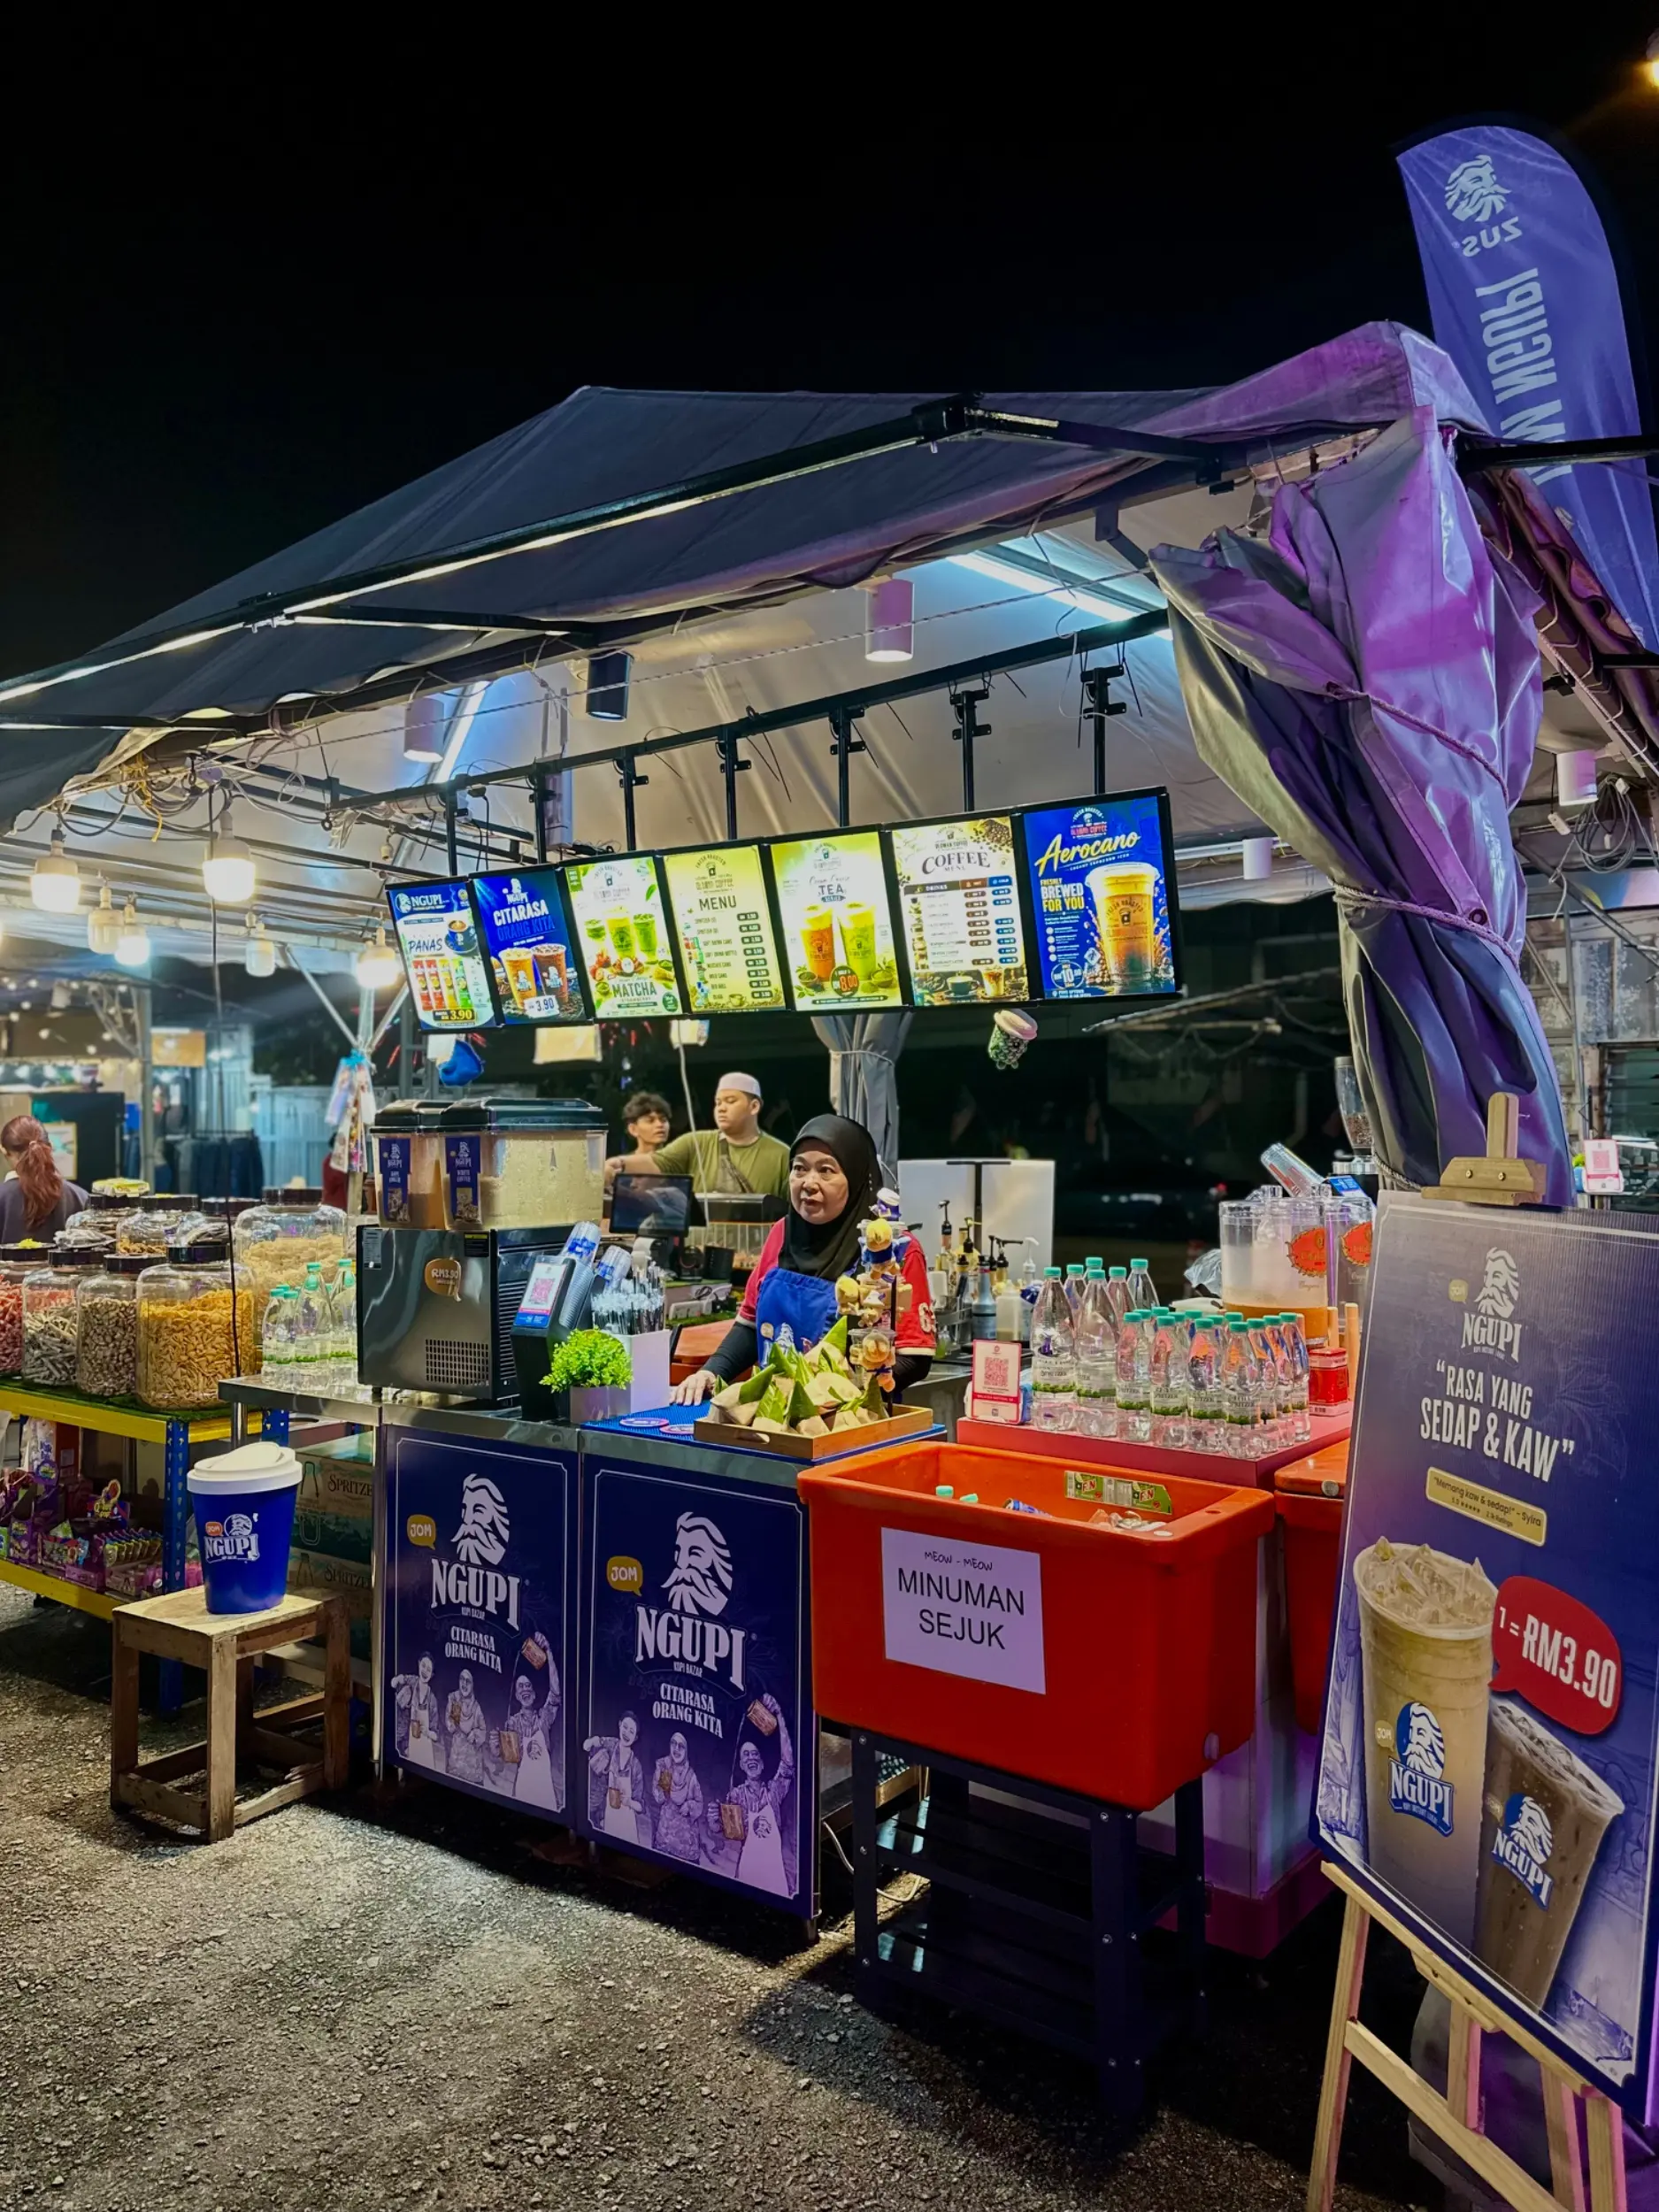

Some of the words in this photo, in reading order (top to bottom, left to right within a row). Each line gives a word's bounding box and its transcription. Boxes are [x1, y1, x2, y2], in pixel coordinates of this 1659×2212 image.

[922, 852, 991, 875] COFFEE
[1034, 831, 1141, 878] Aerocano
[411, 894, 442, 907] NGUPI
[818, 884, 844, 895] TEA
[1041, 882, 1084, 900] BREWED
[493, 899, 549, 926] CITARASA
[699, 895, 737, 911] MENU
[1042, 899, 1062, 912] FOR
[1064, 895, 1085, 910] YOU
[497, 920, 531, 941] ORANG
[533, 915, 556, 933] KITA
[408, 937, 442, 953] PANAS
[612, 981, 657, 998] MATCHA
[449, 1010, 472, 1020] 3.90
[535, 997, 555, 1011] 3.90
[1461, 1311, 1522, 1363] NGUPI
[1491, 1374, 1532, 1420] YANG
[1420, 1397, 1480, 1450] SEDAP
[1483, 1412, 1500, 1459] &
[327, 1474, 373, 1496] SPRITZE
[1464, 1490, 1479, 1502] kaw
[410, 1524, 432, 1537] JOM
[204, 1533, 259, 1560] NGUPI
[924, 1550, 952, 1564] MEOW
[963, 1557, 993, 1571] MEOW
[611, 1566, 638, 1582] JOM
[431, 1557, 521, 1631] NGUPI
[898, 1567, 1025, 1616] MINUMAN
[450, 1625, 495, 1652] CITARASA
[919, 1609, 1006, 1650] SEJUK
[444, 1642, 478, 1661] ORANG
[479, 1649, 503, 1674] KITA
[635, 1605, 746, 1692] NGUPI
[1522, 1613, 1617, 1709] RM3.90
[672, 1661, 685, 1672] KOPI
[686, 1663, 703, 1678] BAZAR
[660, 1682, 715, 1715] CITARASA
[652, 1701, 694, 1724] ORANG
[695, 1709, 723, 1739] KITA
[1377, 1727, 1392, 1740] JOM
[1391, 1761, 1451, 1827] NGUPI
[1491, 1827, 1553, 1907] NGUPI
